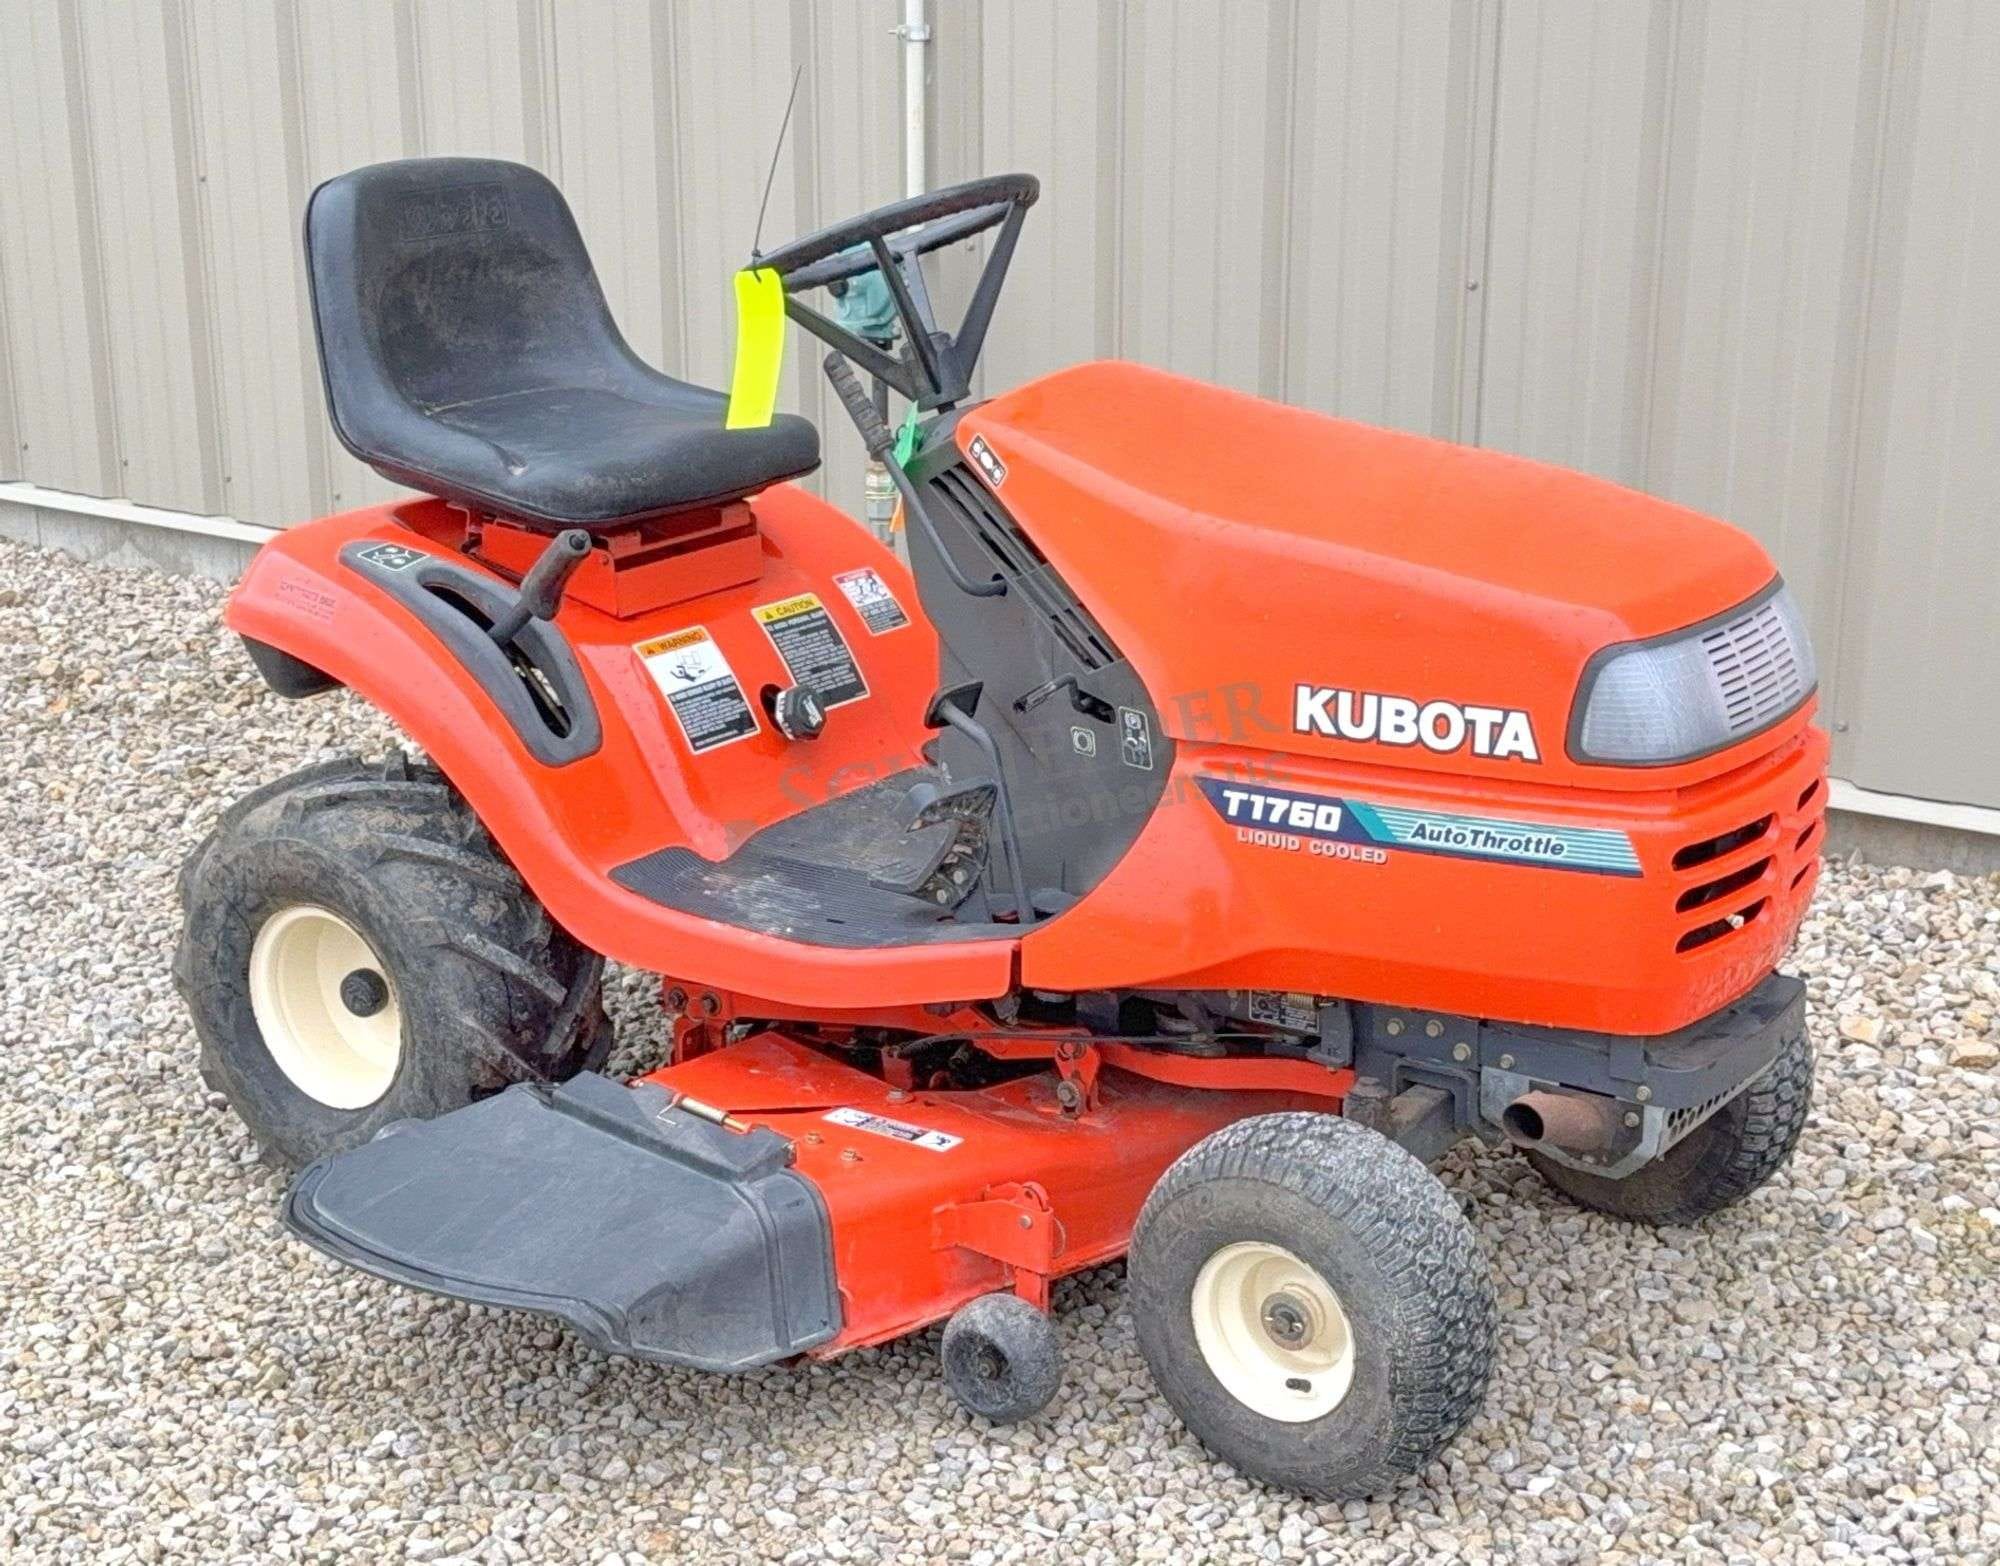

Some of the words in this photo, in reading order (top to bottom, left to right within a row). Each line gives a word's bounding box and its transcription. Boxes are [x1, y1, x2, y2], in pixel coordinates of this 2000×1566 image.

[775, 600, 815, 616] CAUTION
[657, 631, 704, 650] WARNING
[1294, 684, 1542, 765] KUBOTA
[1223, 790, 1342, 832] T1760
[1237, 829, 1300, 851] LIQUID
[1308, 839, 1388, 865] COOLED
[1411, 823, 1565, 856] AutoThrottle
